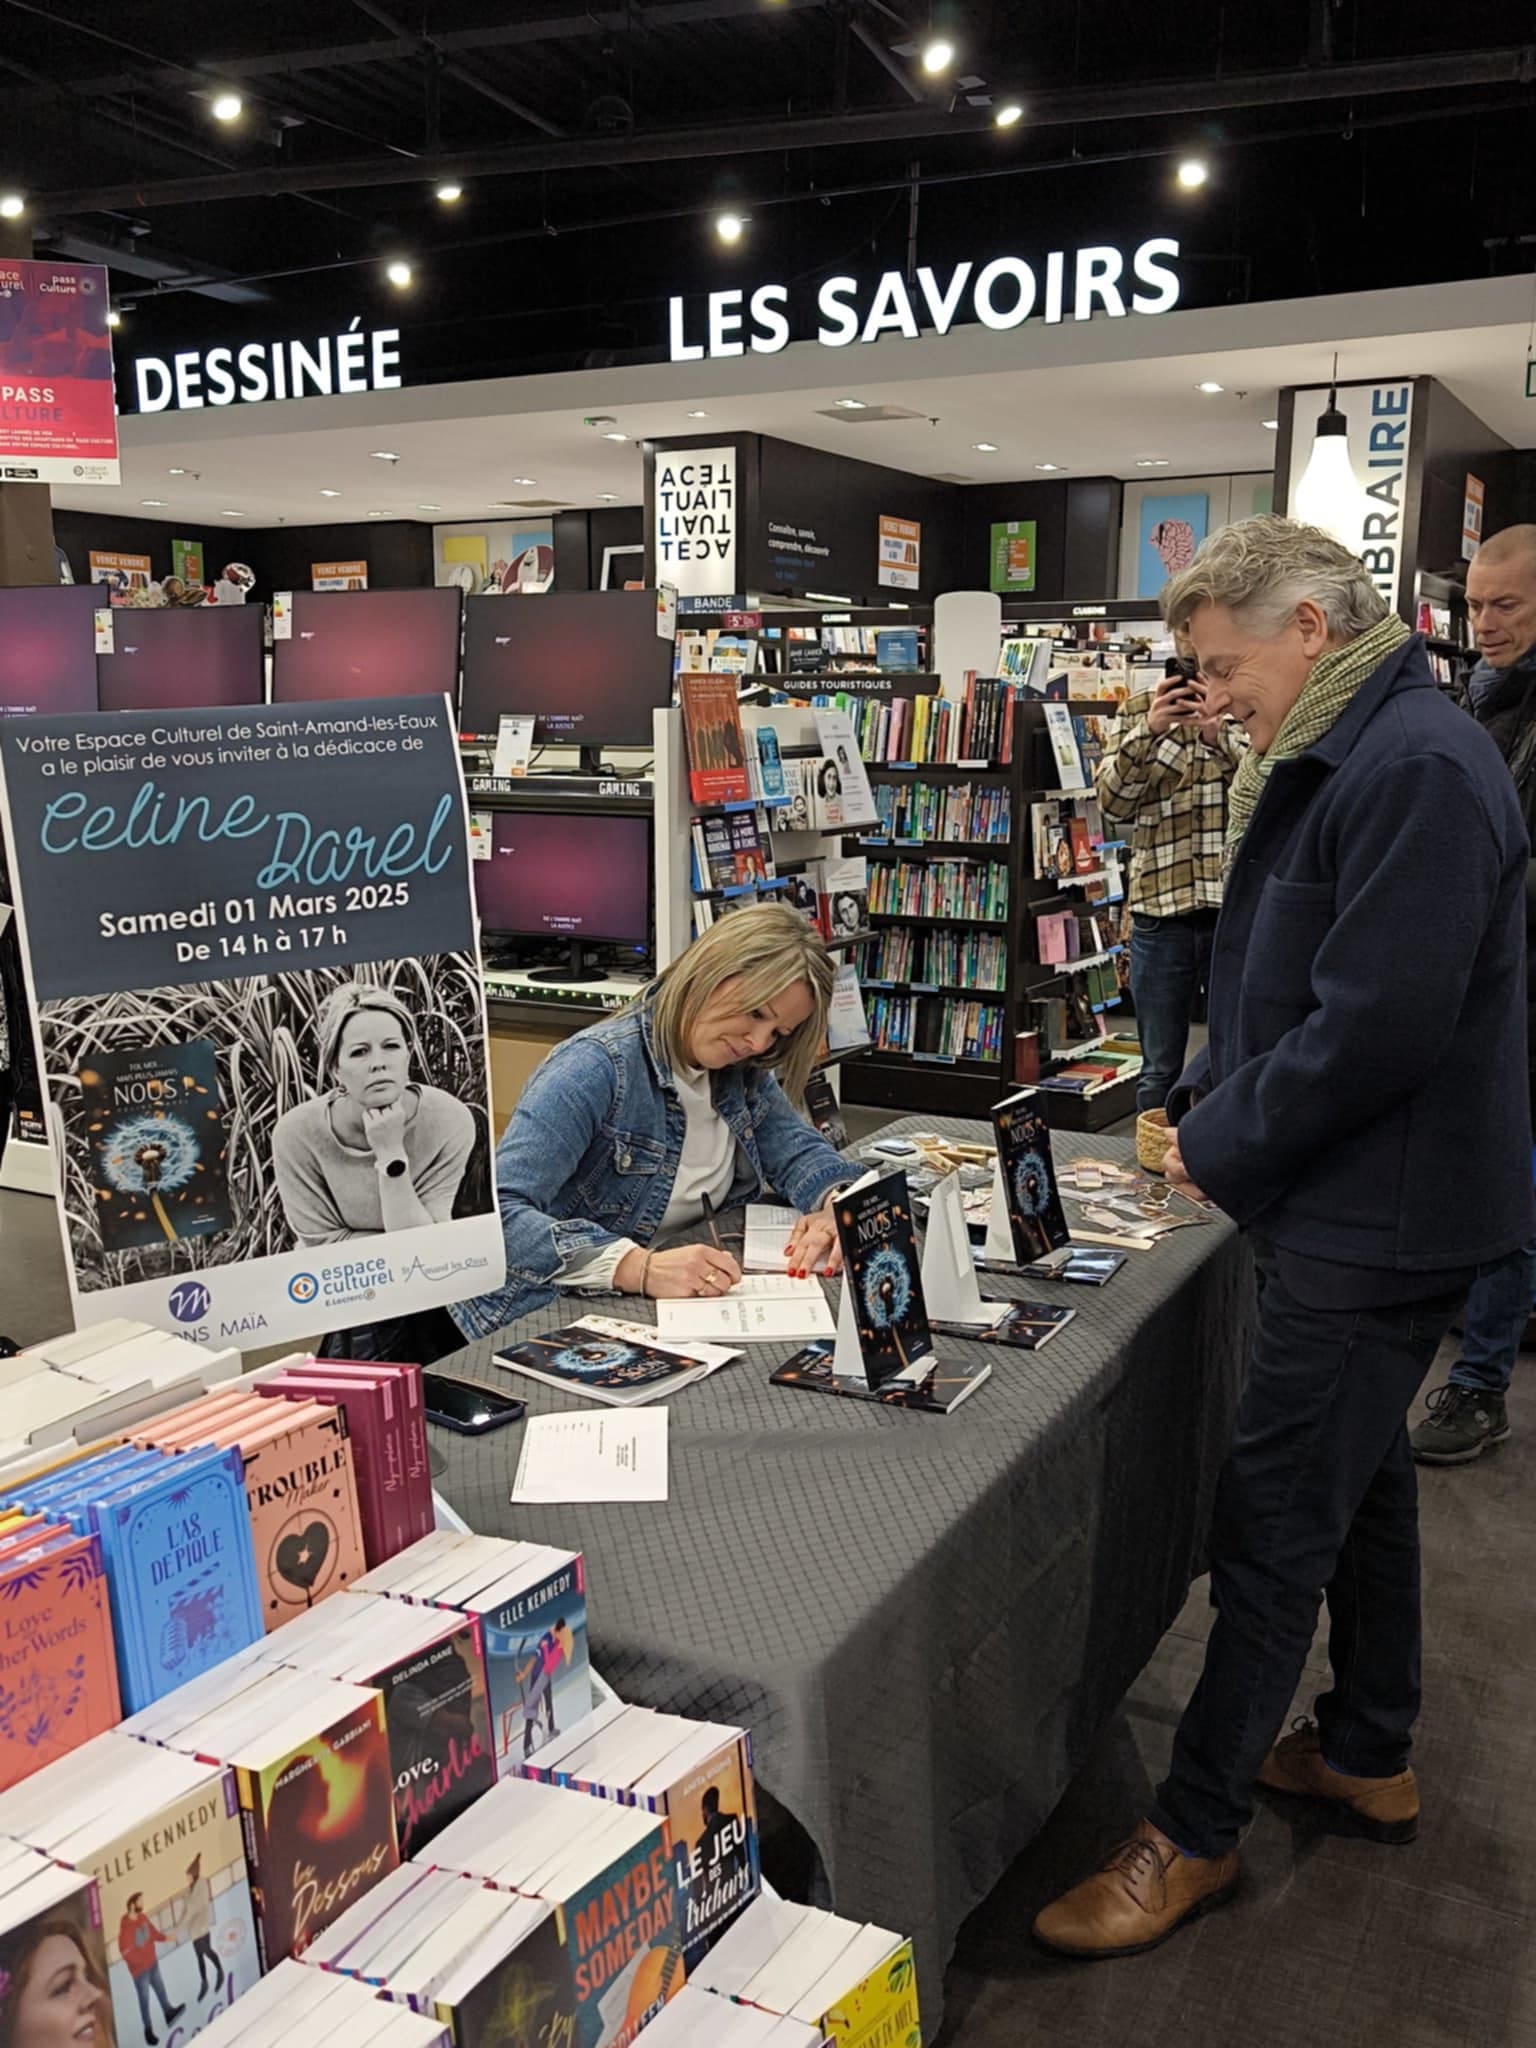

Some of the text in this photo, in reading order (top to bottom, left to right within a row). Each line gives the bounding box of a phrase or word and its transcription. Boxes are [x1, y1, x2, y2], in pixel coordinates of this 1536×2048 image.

[39, 283, 77, 294] Culture
[52, 275, 76, 286] pass
[668, 237, 1182, 362] LES SAVOIRS
[135, 315, 403, 414] DESSINÉE
[1, 385, 55, 403] PASS
[693, 597, 733, 609] BANDE
[783, 680, 893, 691] GUIDES TOURISTIQUES
[15, 714, 438, 754] Votre Espace Culturel de Saint-Amand-les-Eaux
[40, 734, 424, 777] a le plaisir de vous inviter à la dédicace de
[472, 778, 511, 792] GAMING
[599, 782, 640, 796] GAMING
[40, 781, 272, 854] Celine
[256, 793, 454, 890] Darel
[99, 882, 410, 938] Samedi 01 Mars 2025
[175, 924, 348, 963] De 14 h à 17 h
[113, 1078, 178, 1107] NOUS
[856, 1209, 892, 1245] NOUS
[320, 1257, 386, 1282] espace
[322, 1269, 394, 1296] culturel
[219, 1312, 268, 1337] MAÏA
[246, 1446, 347, 1513] TROUBLE
[167, 1511, 202, 1551] L'AS
[151, 1527, 225, 1586] DE PIQUE
[499, 1572, 572, 1630] ELLE KENNEDY
[5, 1606, 52, 1640] Love
[30, 1615, 87, 1653] Words
[391, 1645, 454, 1686] DELINDA DANE
[391, 1755, 440, 1794] ove,
[95, 1798, 219, 1890] ELLE KENNEDY
[675, 1811, 747, 1890] LE JEU
[573, 1846, 667, 1958] MAYBE
[574, 1885, 675, 2003] SOMEDAY
